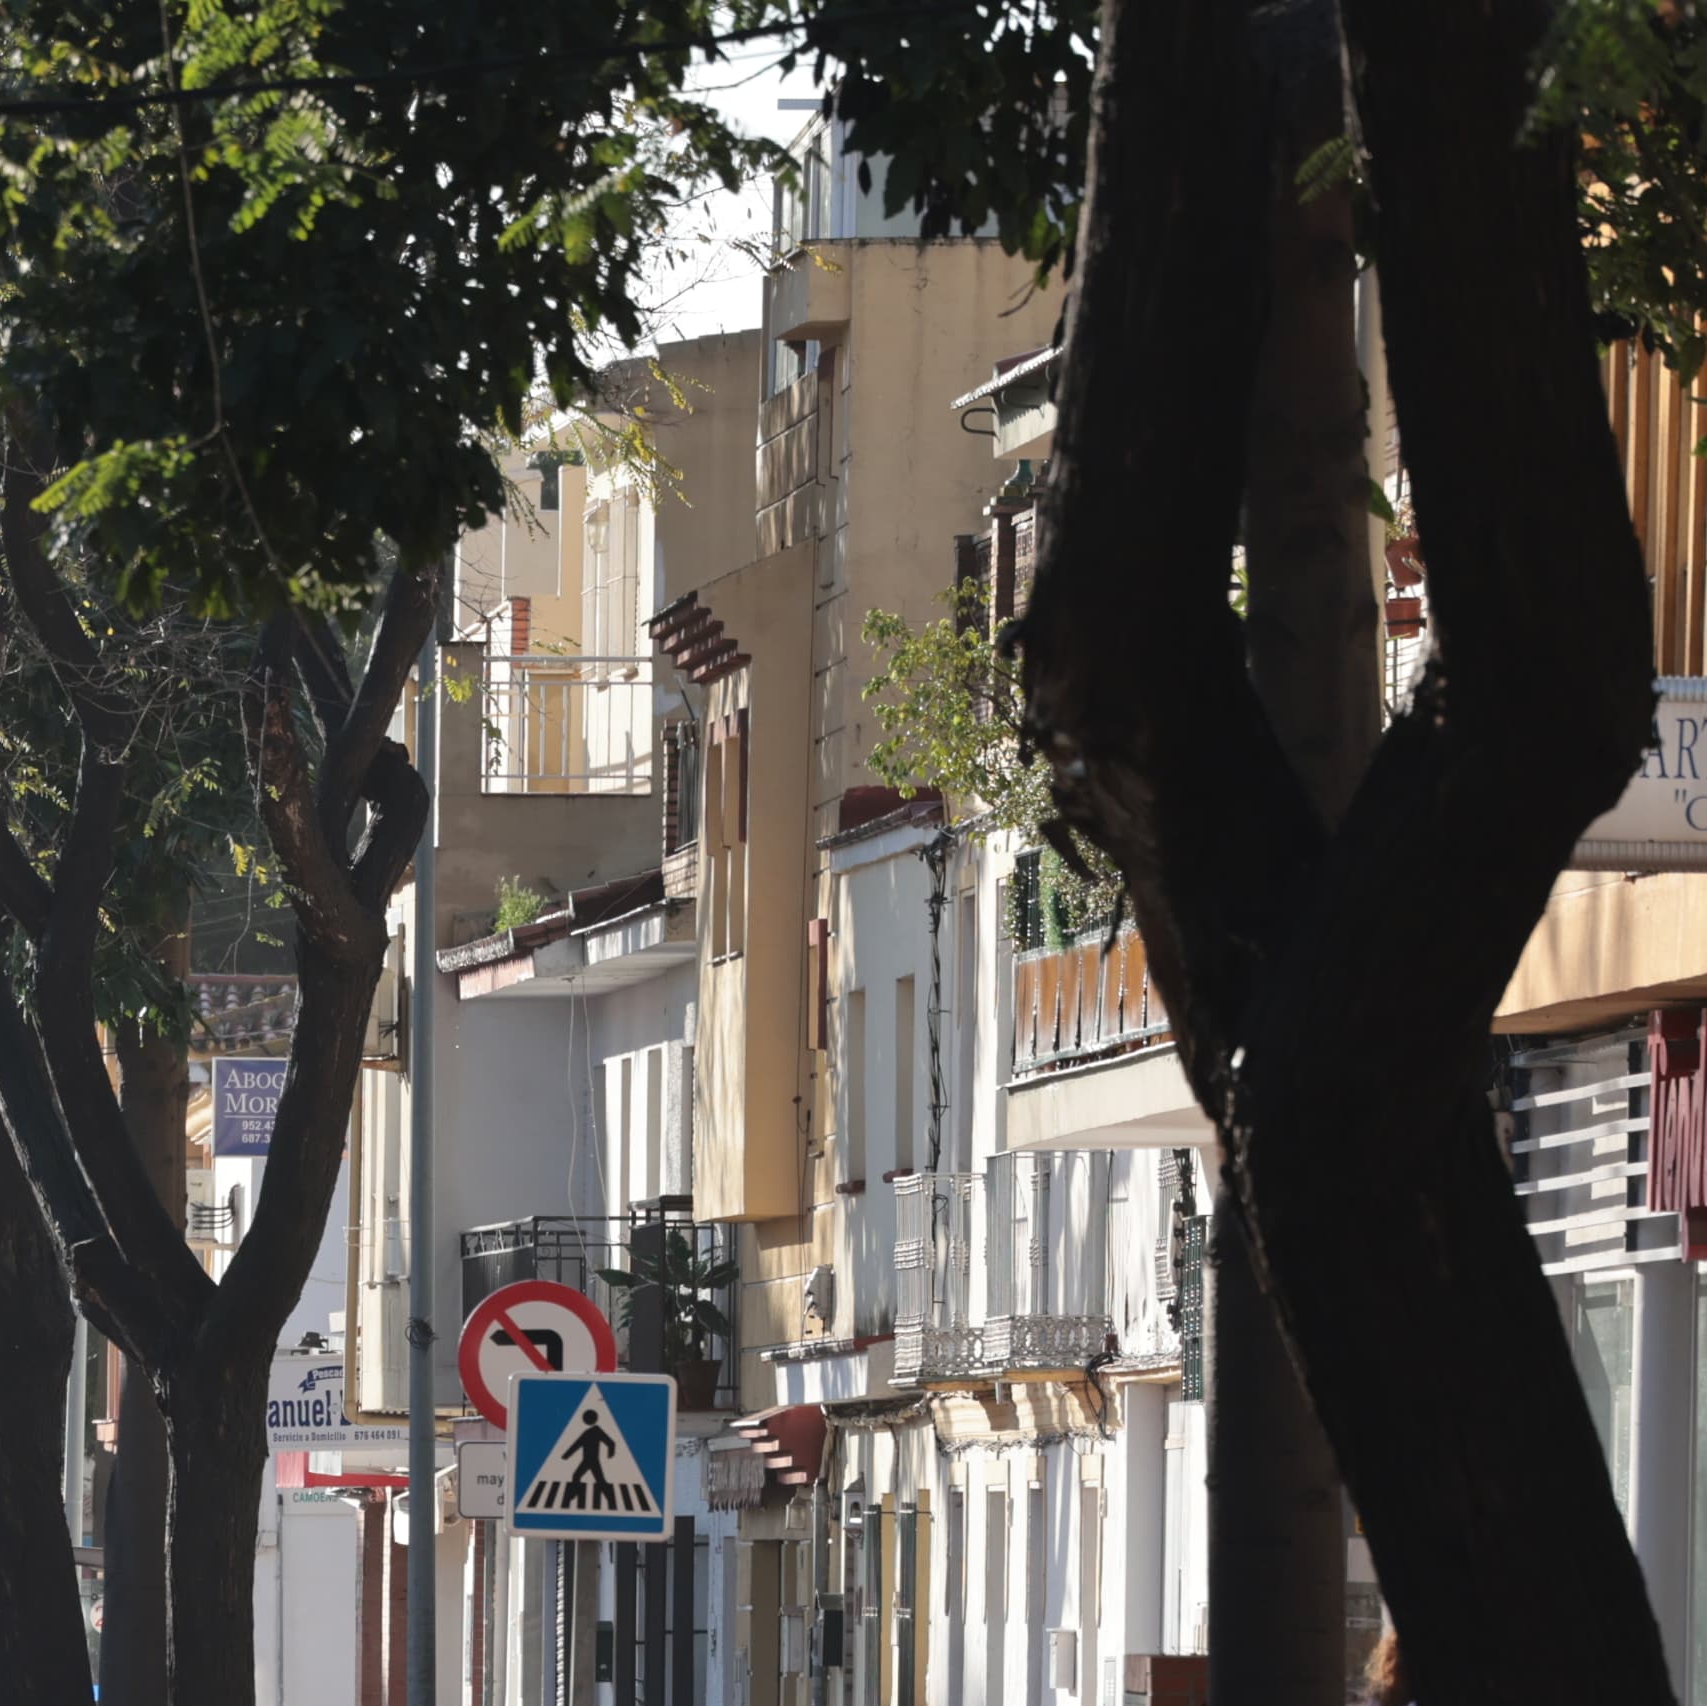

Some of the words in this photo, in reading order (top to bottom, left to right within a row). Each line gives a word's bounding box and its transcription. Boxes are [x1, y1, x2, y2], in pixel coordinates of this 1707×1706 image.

[1639, 717, 1707, 779] AR
[1647, 1028, 1707, 1263] Tiend
[273, 1432, 303, 1442] Servicio
[311, 1431, 347, 1441] Domicilio
